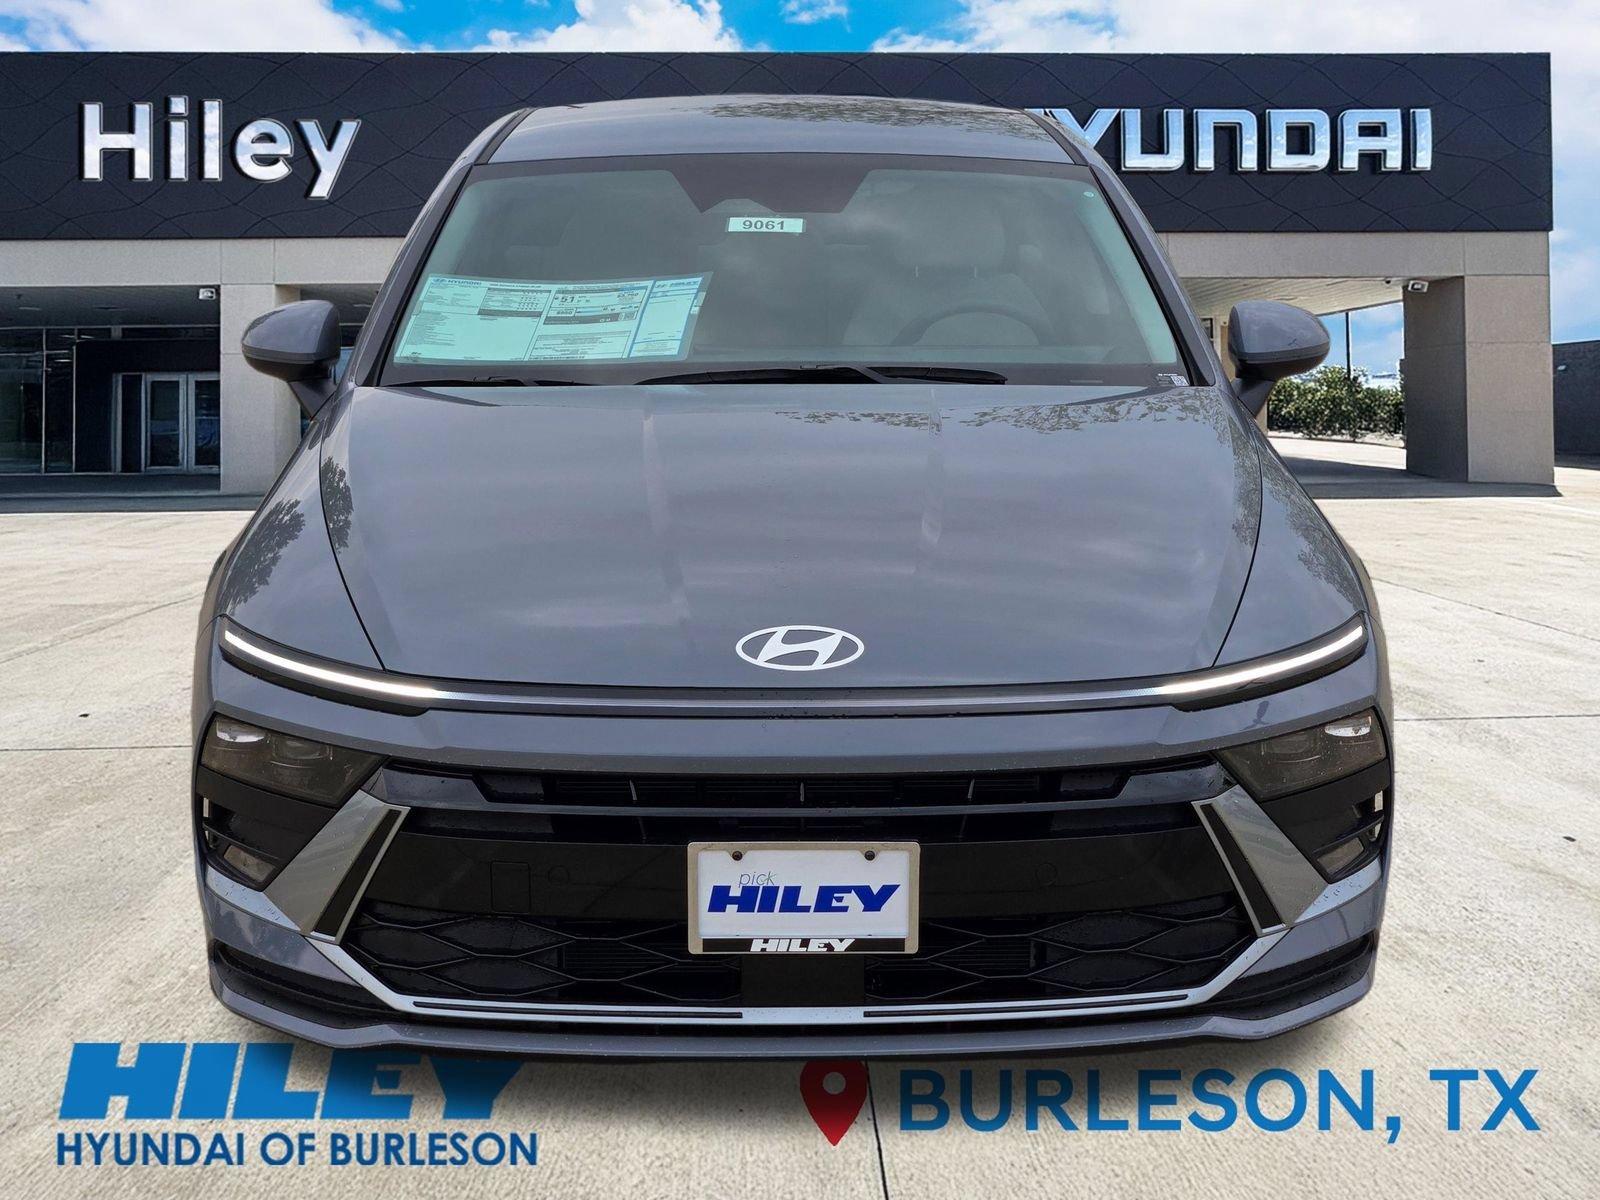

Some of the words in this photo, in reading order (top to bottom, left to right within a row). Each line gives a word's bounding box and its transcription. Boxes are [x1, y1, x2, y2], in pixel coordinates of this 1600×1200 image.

[79, 95, 362, 200] Hiley
[1024, 108, 1433, 171] YUNDAI
[742, 219, 785, 230] 9061
[738, 871, 776, 888] pick
[708, 884, 900, 912] HILEY
[750, 938, 855, 952] HILEY
